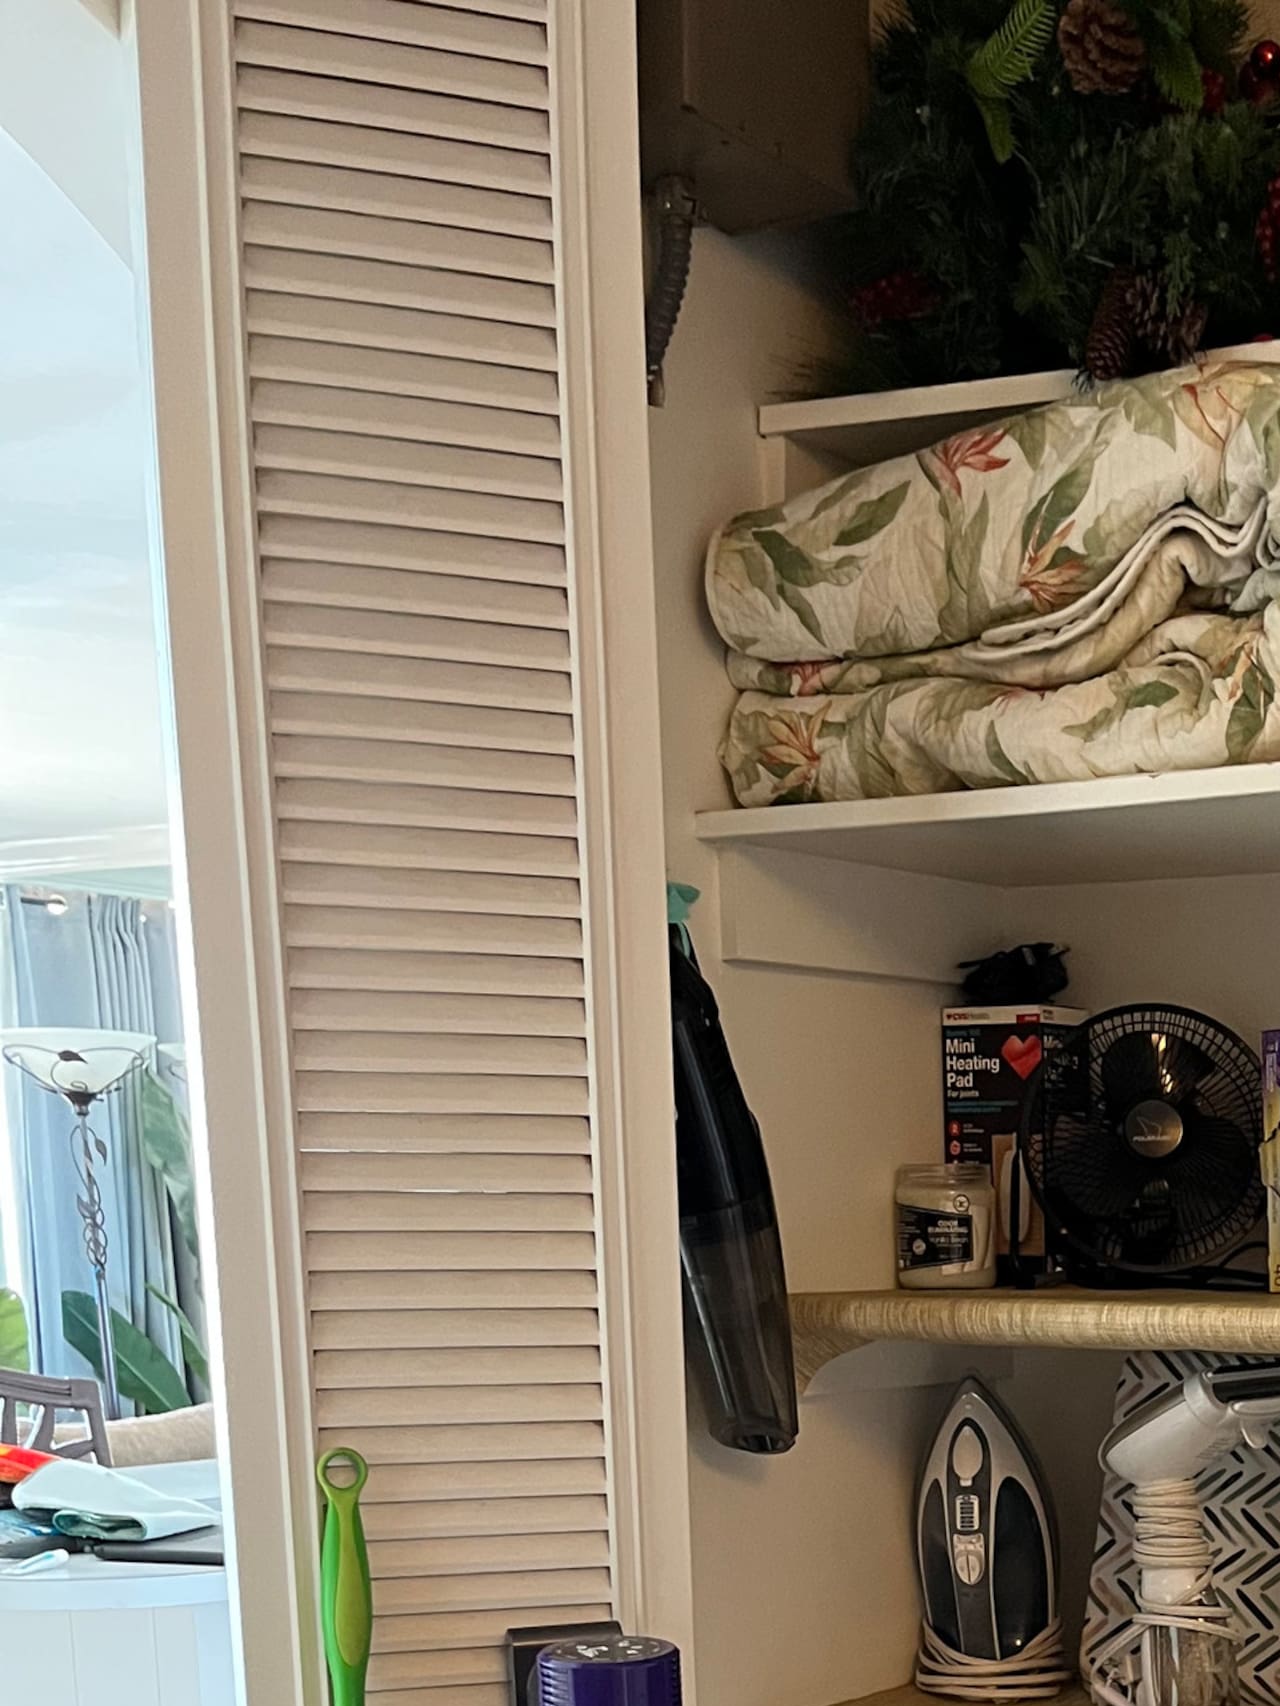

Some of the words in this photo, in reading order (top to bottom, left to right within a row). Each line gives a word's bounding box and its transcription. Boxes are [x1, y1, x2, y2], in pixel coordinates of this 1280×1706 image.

[946, 1038, 975, 1054] Mini
[946, 1054, 1000, 1073] Heating
[946, 1072, 973, 1087] Pad
